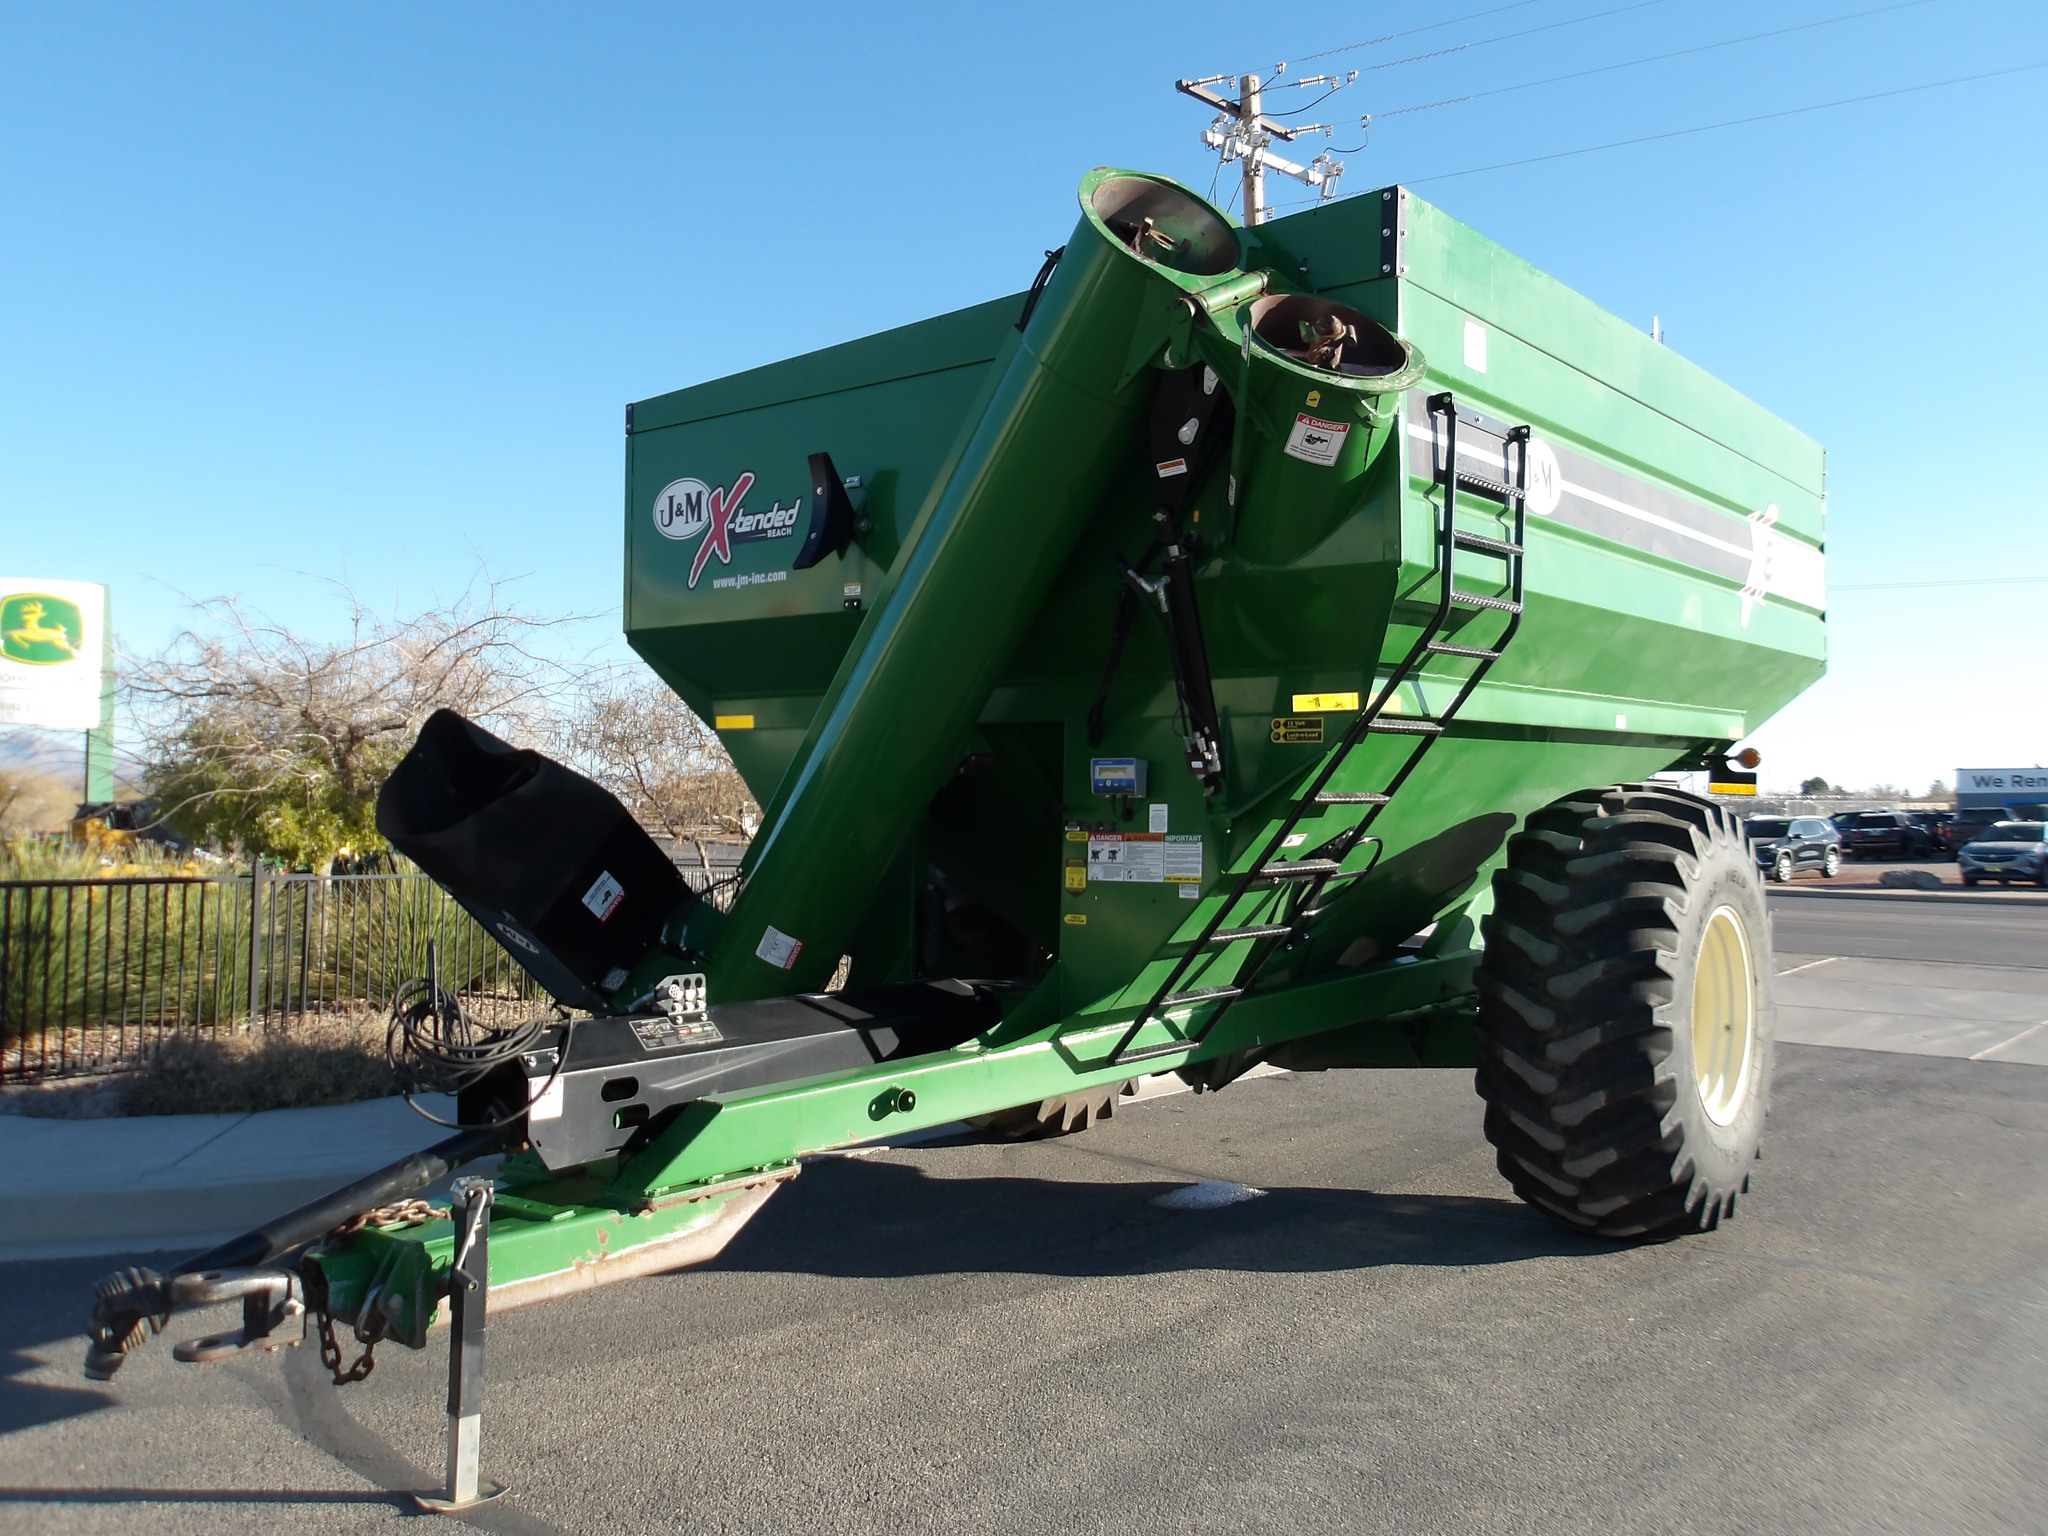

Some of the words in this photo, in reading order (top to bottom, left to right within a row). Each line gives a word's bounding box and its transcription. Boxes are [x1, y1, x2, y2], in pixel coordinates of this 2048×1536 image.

[1310, 419, 1344, 431] DANGER
[659, 489, 705, 528] J&M
[767, 527, 793, 539] REACH
[713, 570, 787, 590] www.jm-inc.com
[1972, 775, 2004, 788] We
[1096, 834, 1122, 842] DANGER
[1165, 834, 1202, 842] IMPORTANT
[600, 895, 623, 922] DANGER
[785, 945, 802, 970] DANGER
